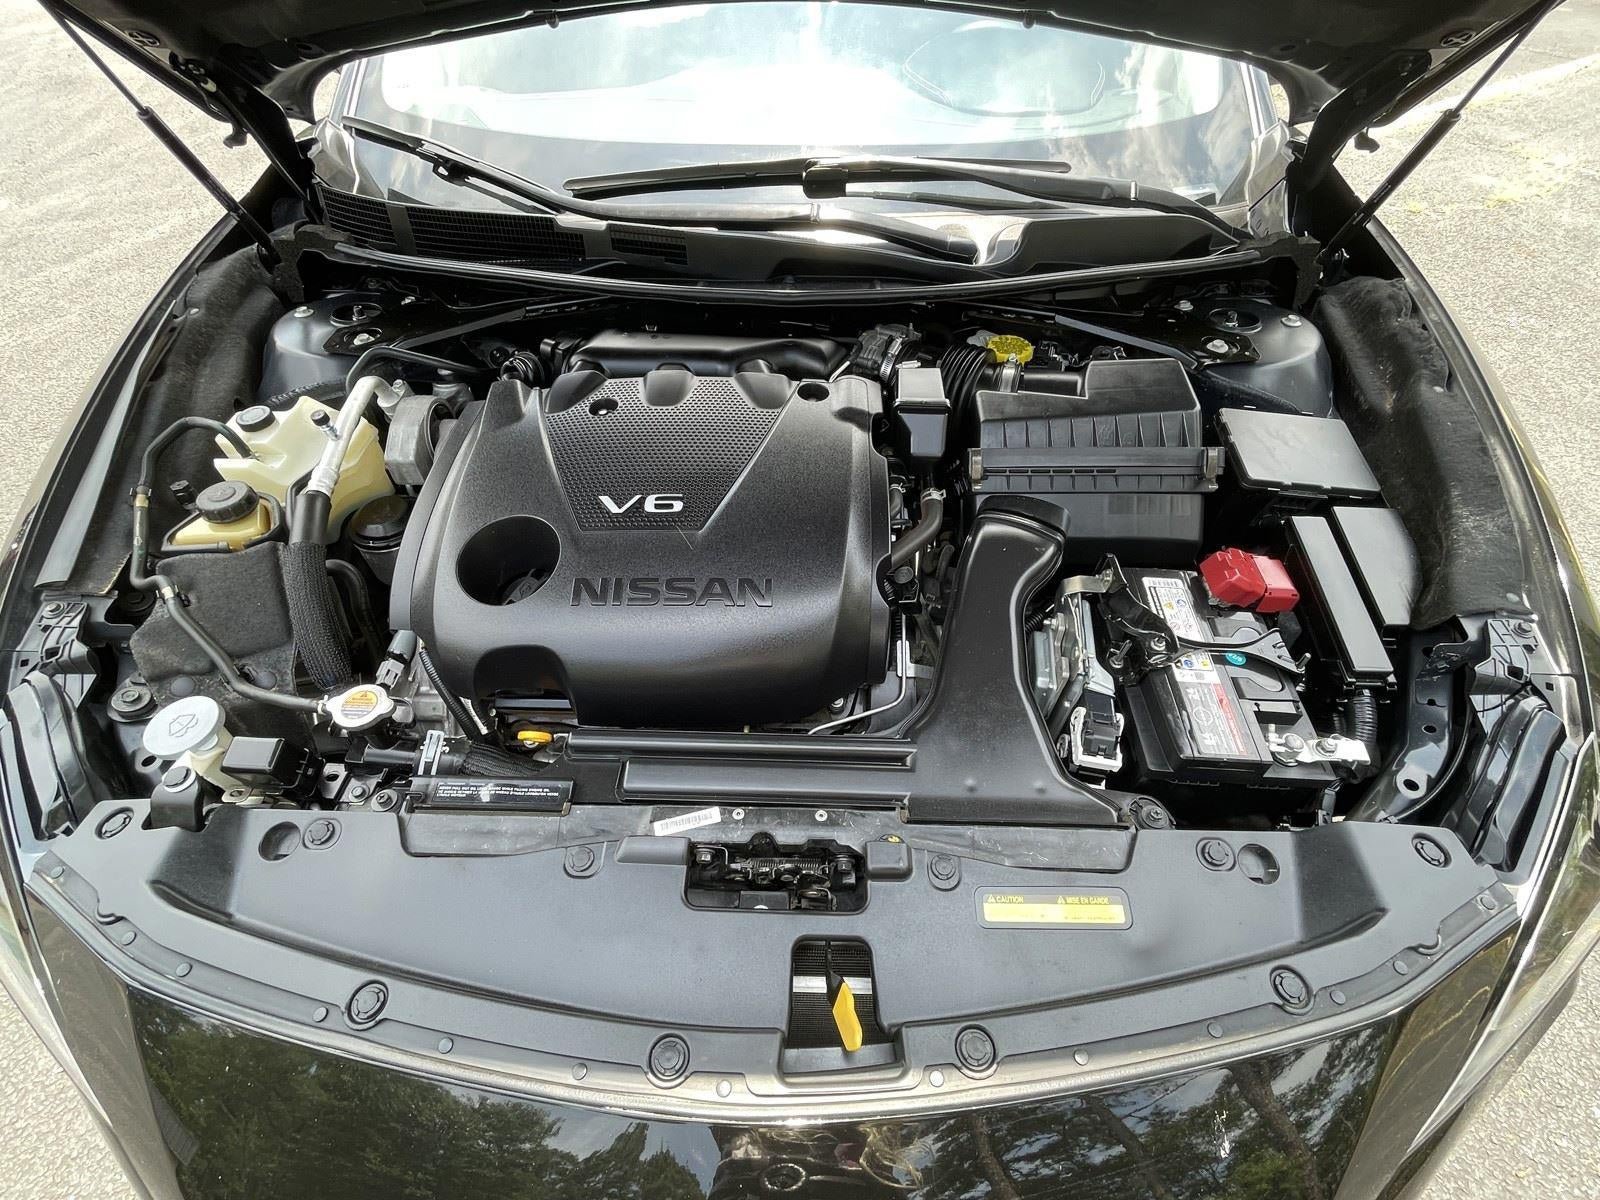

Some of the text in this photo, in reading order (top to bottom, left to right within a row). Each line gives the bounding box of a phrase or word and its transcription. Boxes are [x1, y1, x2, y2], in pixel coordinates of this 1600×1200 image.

[598, 493, 684, 514] V6
[570, 577, 773, 607] NISSAN
[996, 896, 1024, 904] CAUTION
